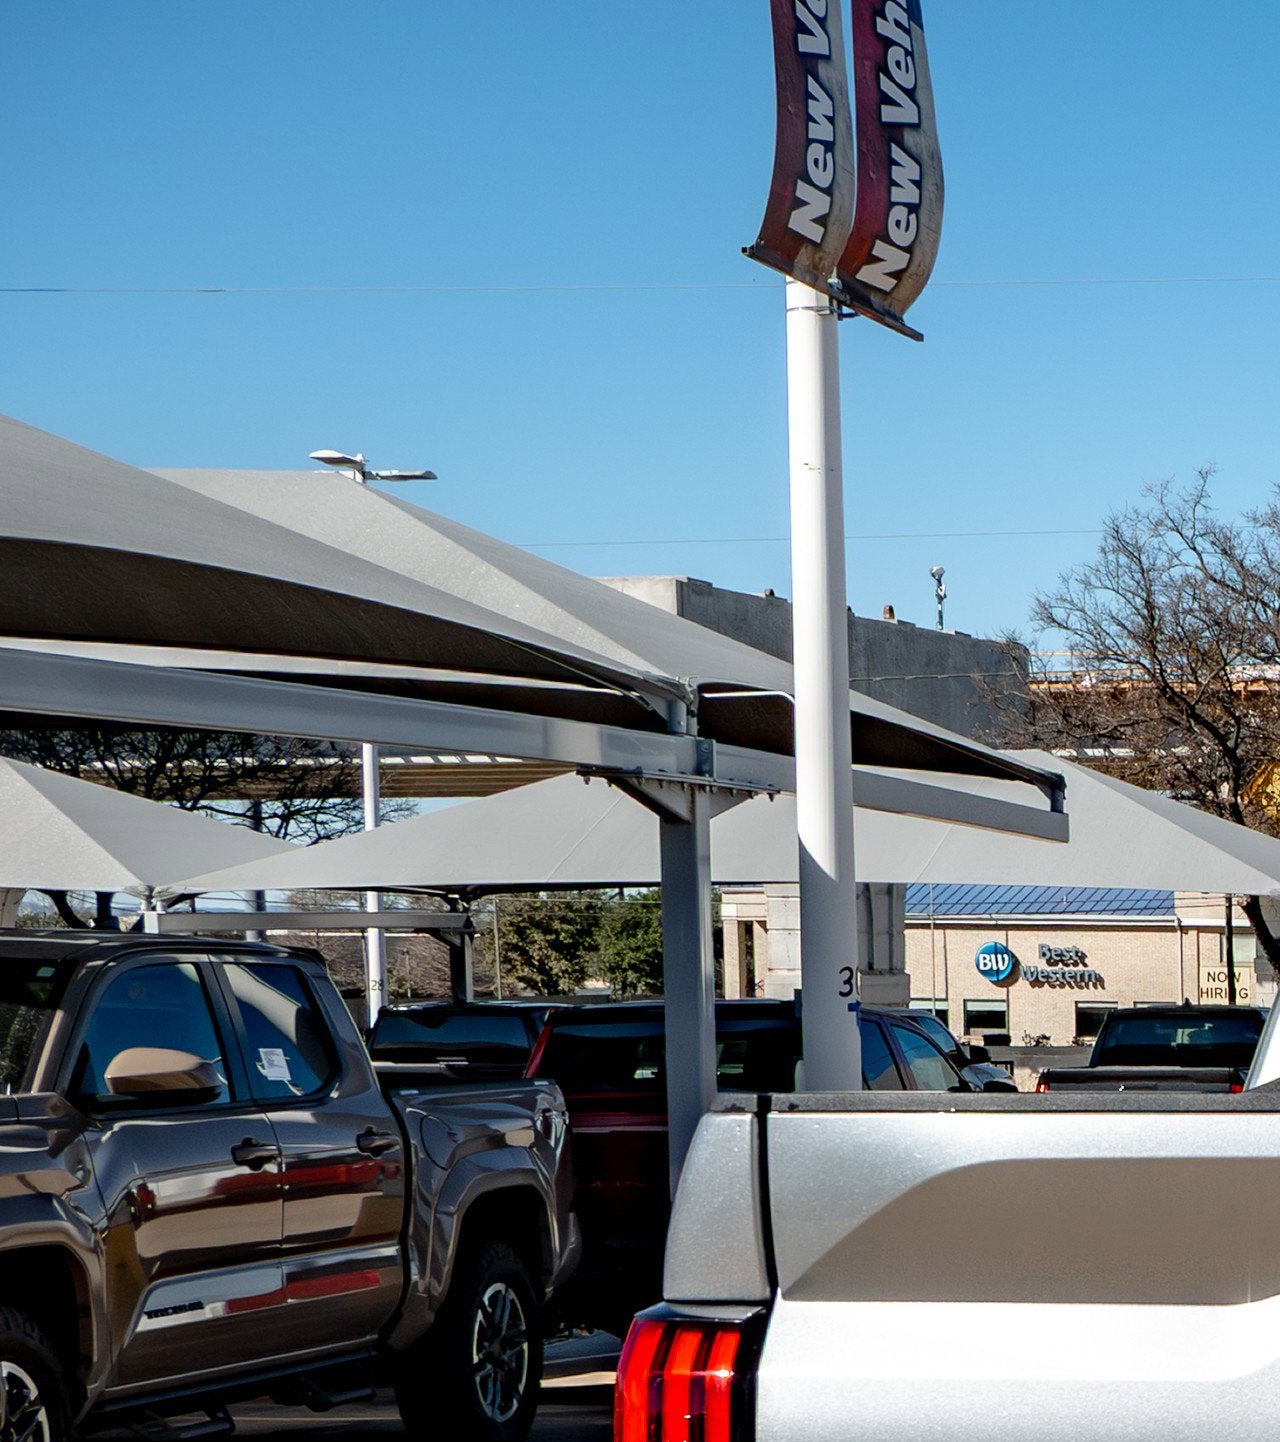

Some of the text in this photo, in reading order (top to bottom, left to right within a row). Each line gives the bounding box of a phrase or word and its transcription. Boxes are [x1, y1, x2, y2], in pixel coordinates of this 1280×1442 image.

[855, 0, 920, 293] New Veh
[787, 73, 834, 244] New
[1038, 943, 1080, 961] Best
[978, 953, 1009, 971] BW
[1019, 965, 1097, 983] Western
[1200, 987, 1249, 999] HIRIG
